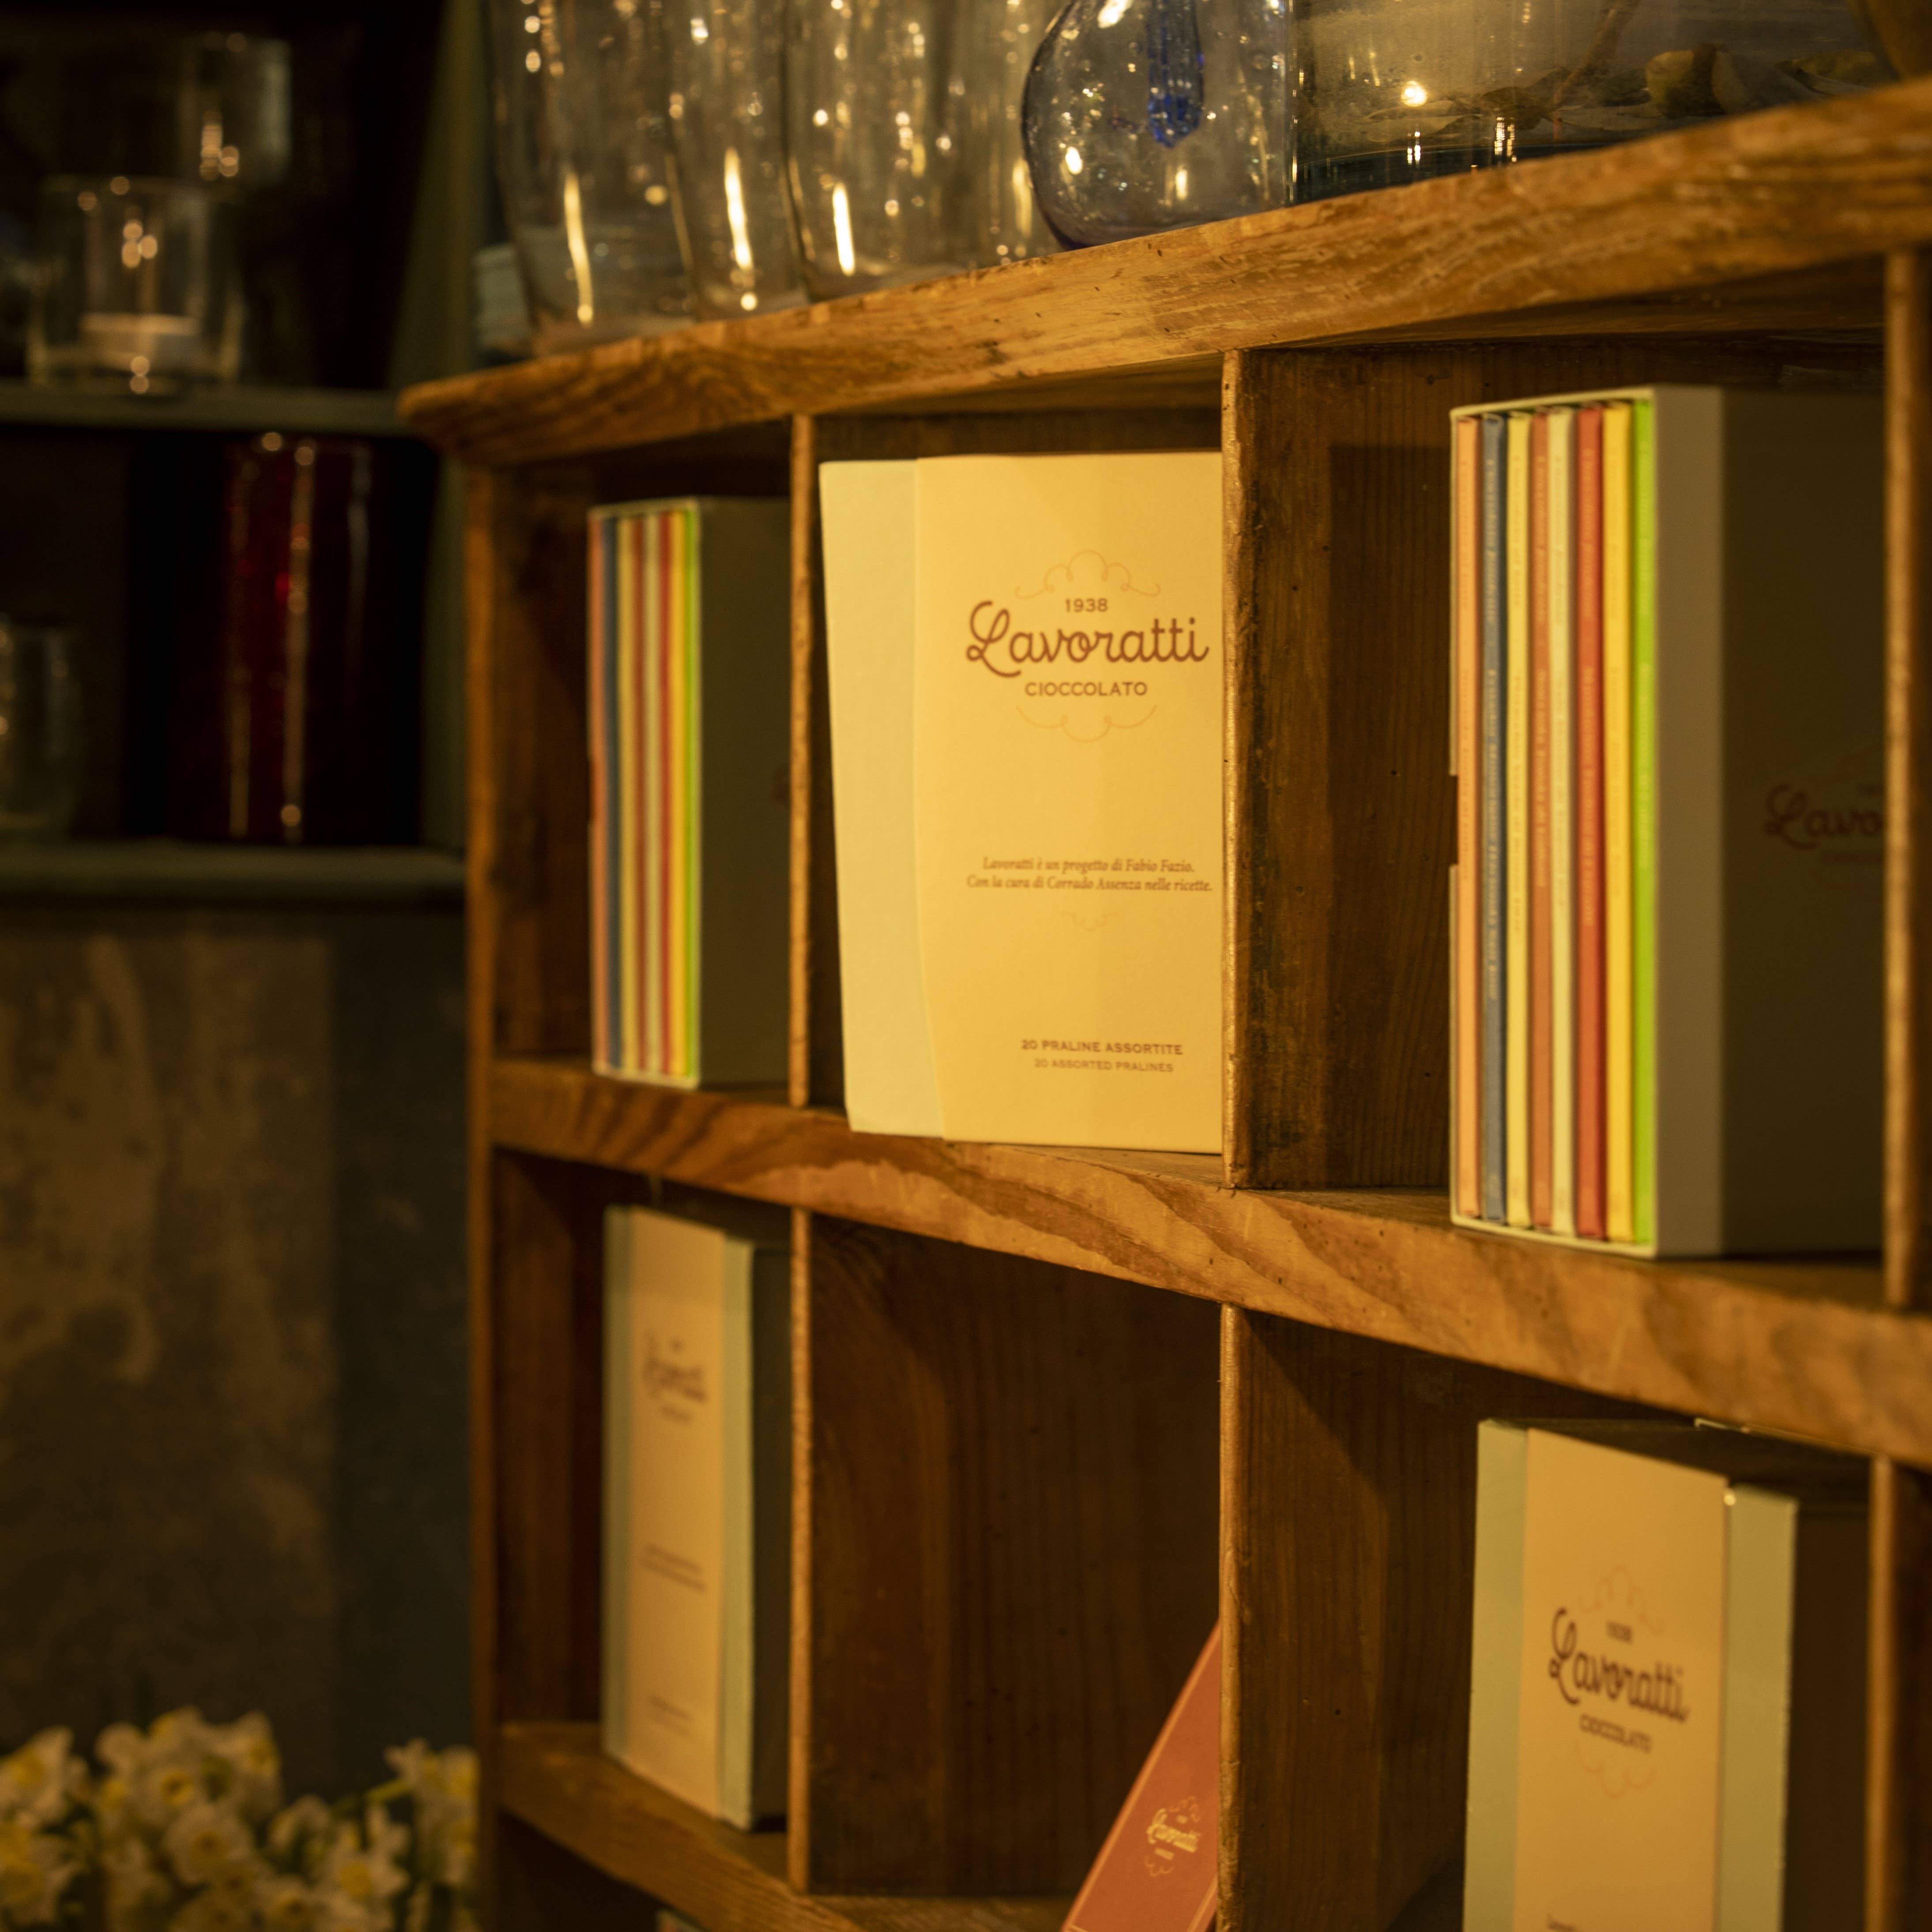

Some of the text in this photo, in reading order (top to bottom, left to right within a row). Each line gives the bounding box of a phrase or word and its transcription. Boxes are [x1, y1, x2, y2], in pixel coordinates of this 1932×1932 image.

[1065, 598, 1108, 612] 1938
[966, 600, 1209, 678] Lavoratti
[1025, 682, 1148, 696] CIOCCOLATO
[1045, 861, 1059, 870] un
[1061, 860, 1108, 875] progetto
[1111, 858, 1123, 871] di
[1126, 859, 1158, 872] Fabio
[1160, 859, 1195, 872] Fazio.
[967, 874, 989, 888] Con
[1005, 879, 1030, 888] cura
[1033, 876, 1044, 888] di
[1047, 875, 1093, 889] Corrado
[1145, 877, 1171, 890] nelle
[1021, 1039, 1183, 1055] 20 PRALINE ASSORTITE
[1035, 1059, 1174, 1073] 20 ASSORTED PRALINES
[1549, 1607, 1689, 1724] Lavoratti
